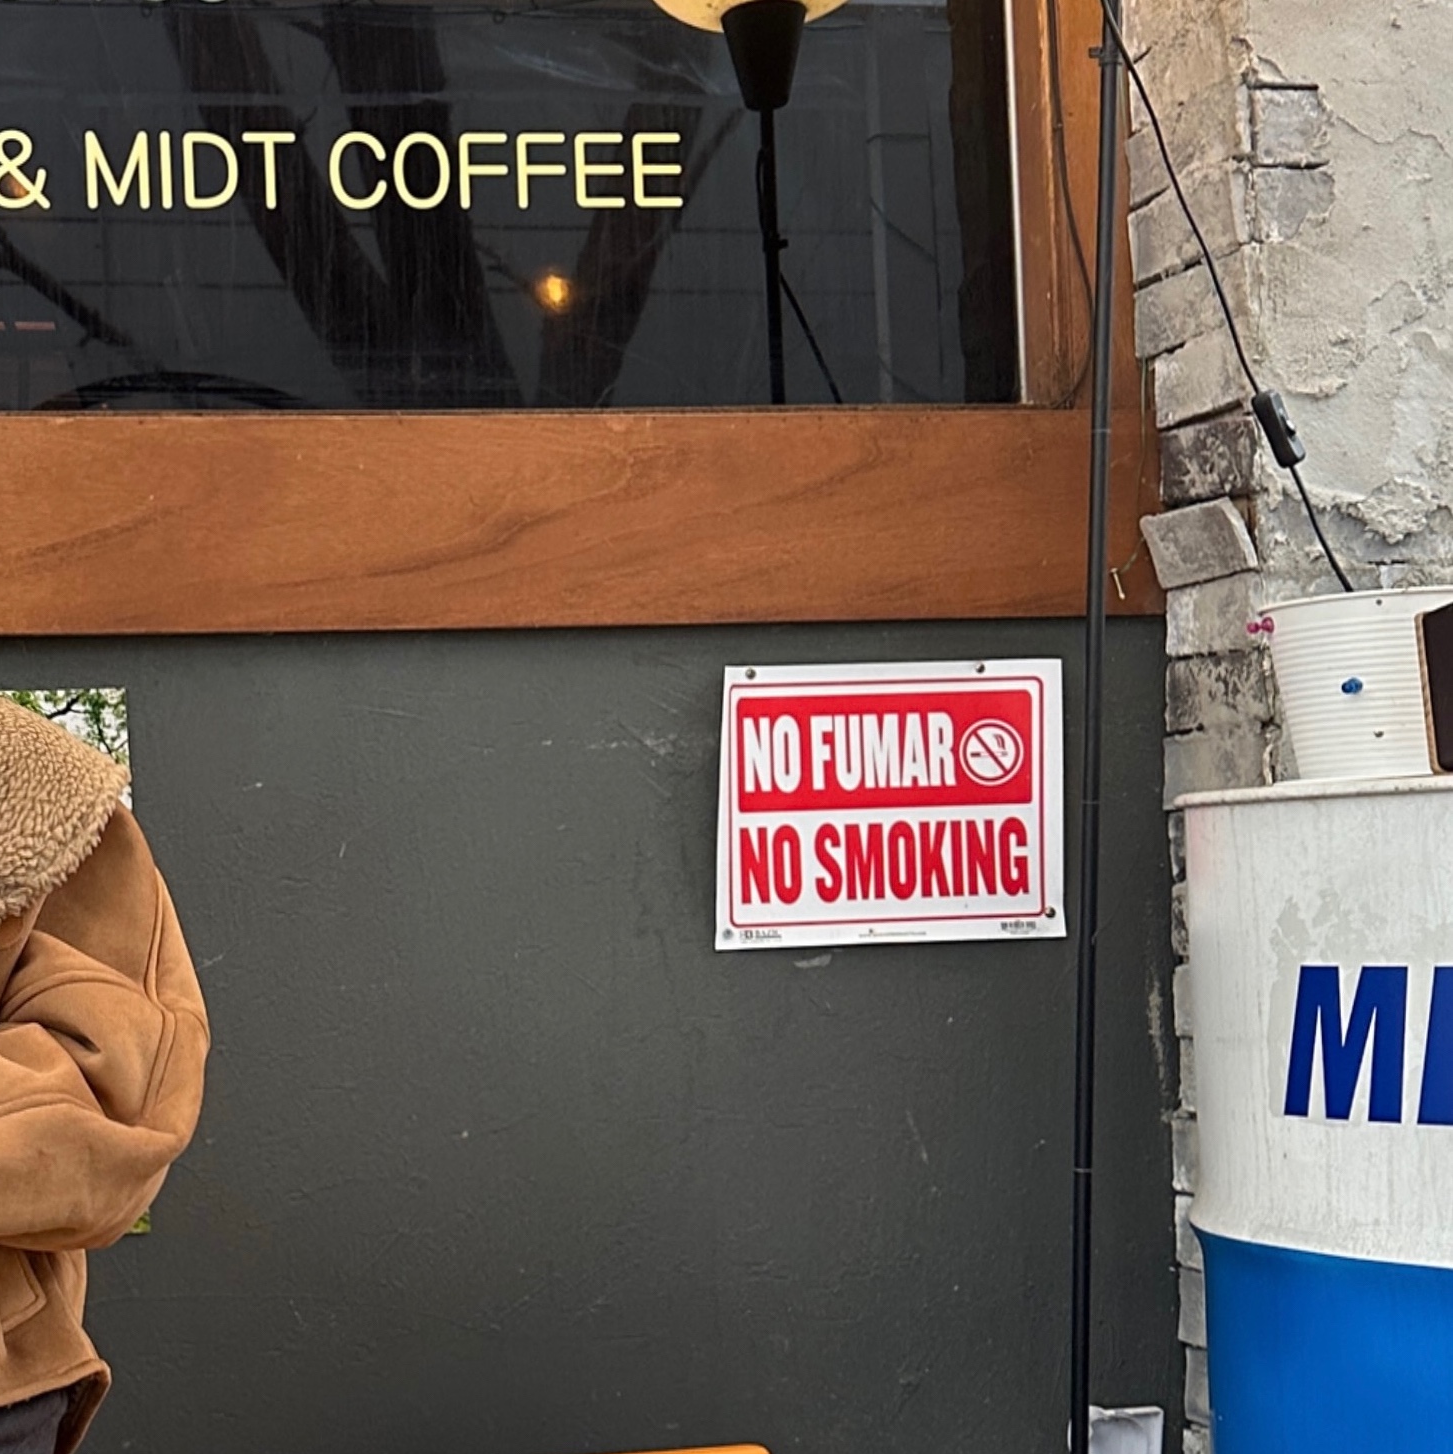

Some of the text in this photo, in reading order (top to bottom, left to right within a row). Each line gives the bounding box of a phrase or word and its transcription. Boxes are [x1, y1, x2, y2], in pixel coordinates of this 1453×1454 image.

[84, 130, 296, 209] MIDT
[328, 130, 684, 209] COFFEE
[742, 711, 957, 794] NO FUMAR
[739, 816, 1030, 904] NO SMOKING
